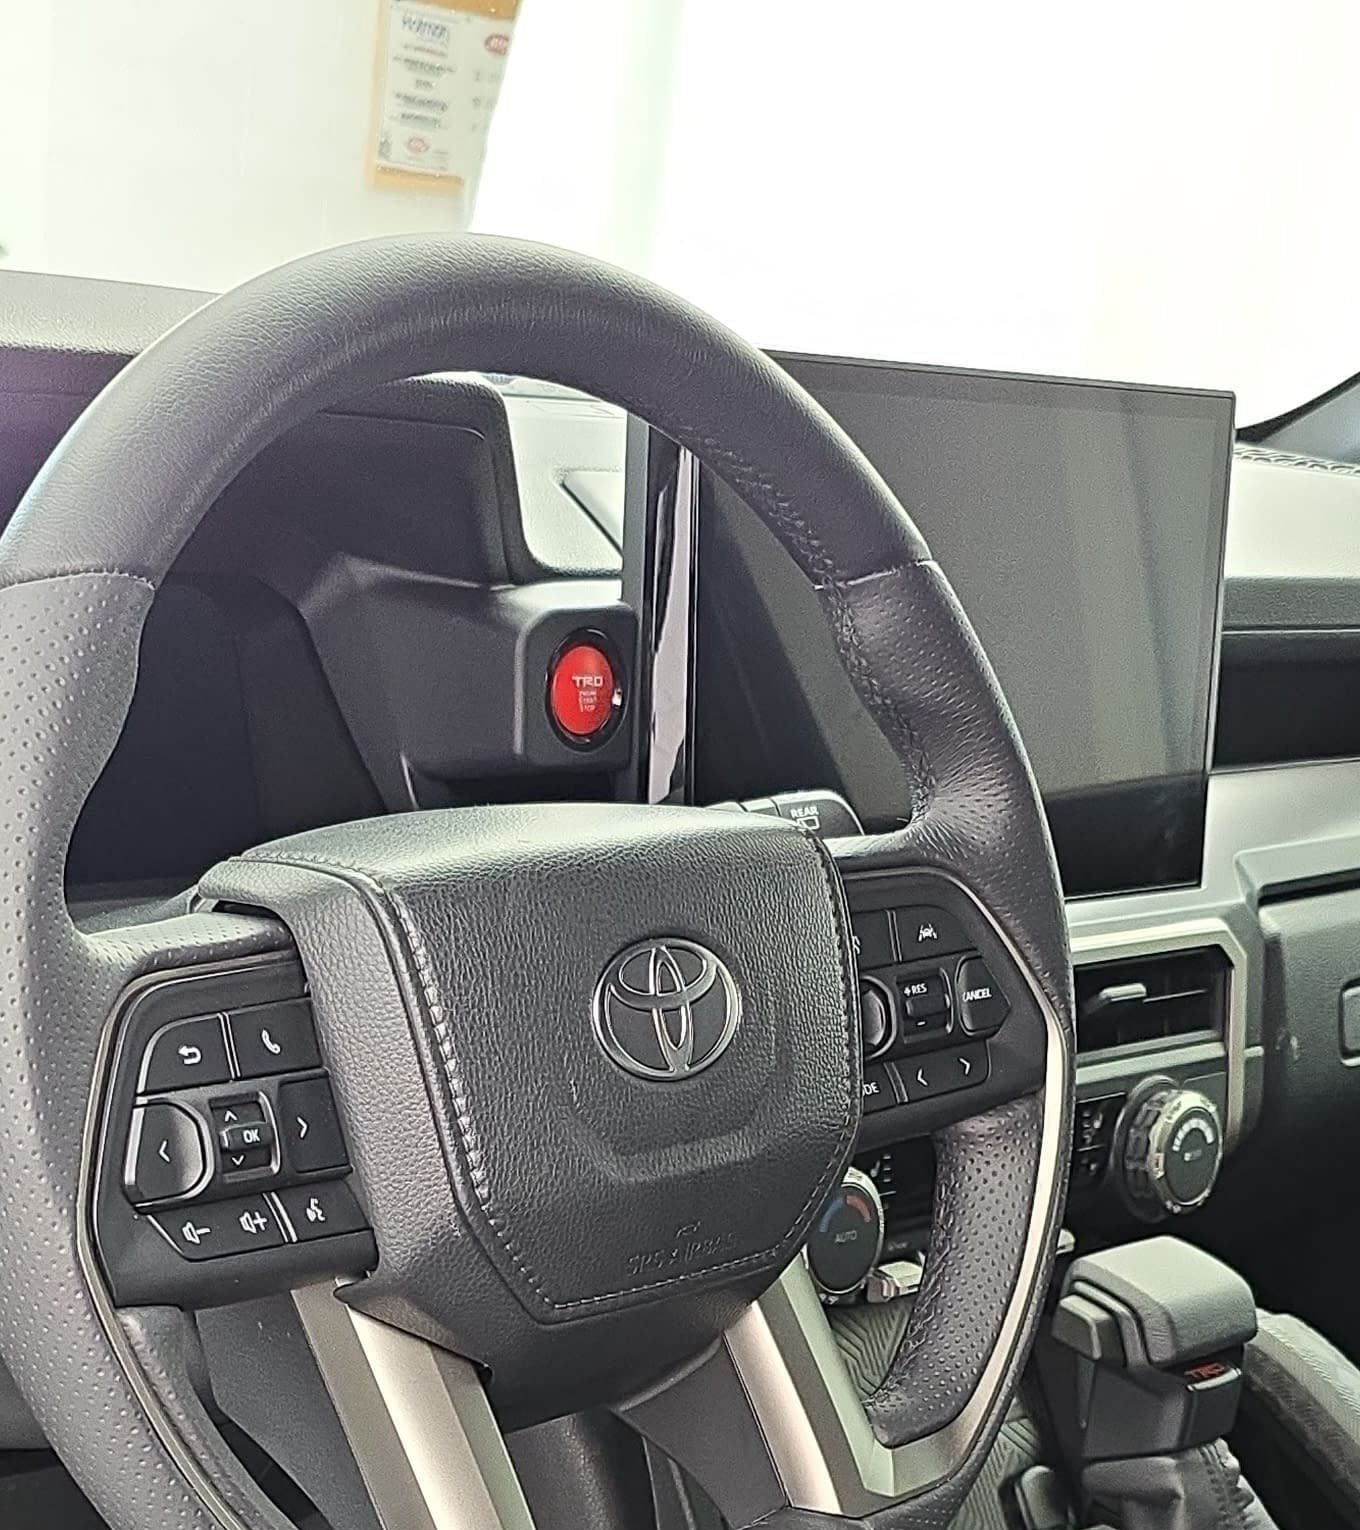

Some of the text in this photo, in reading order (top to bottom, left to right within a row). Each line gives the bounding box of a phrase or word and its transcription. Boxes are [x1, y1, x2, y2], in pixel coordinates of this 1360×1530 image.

[571, 675, 604, 688] TRD
[791, 805, 820, 819] REAR
[962, 987, 992, 1002] CANCEL
[862, 1082, 880, 1097] DE
[242, 1128, 261, 1144] OK
[834, 1230, 859, 1244] AUTO
